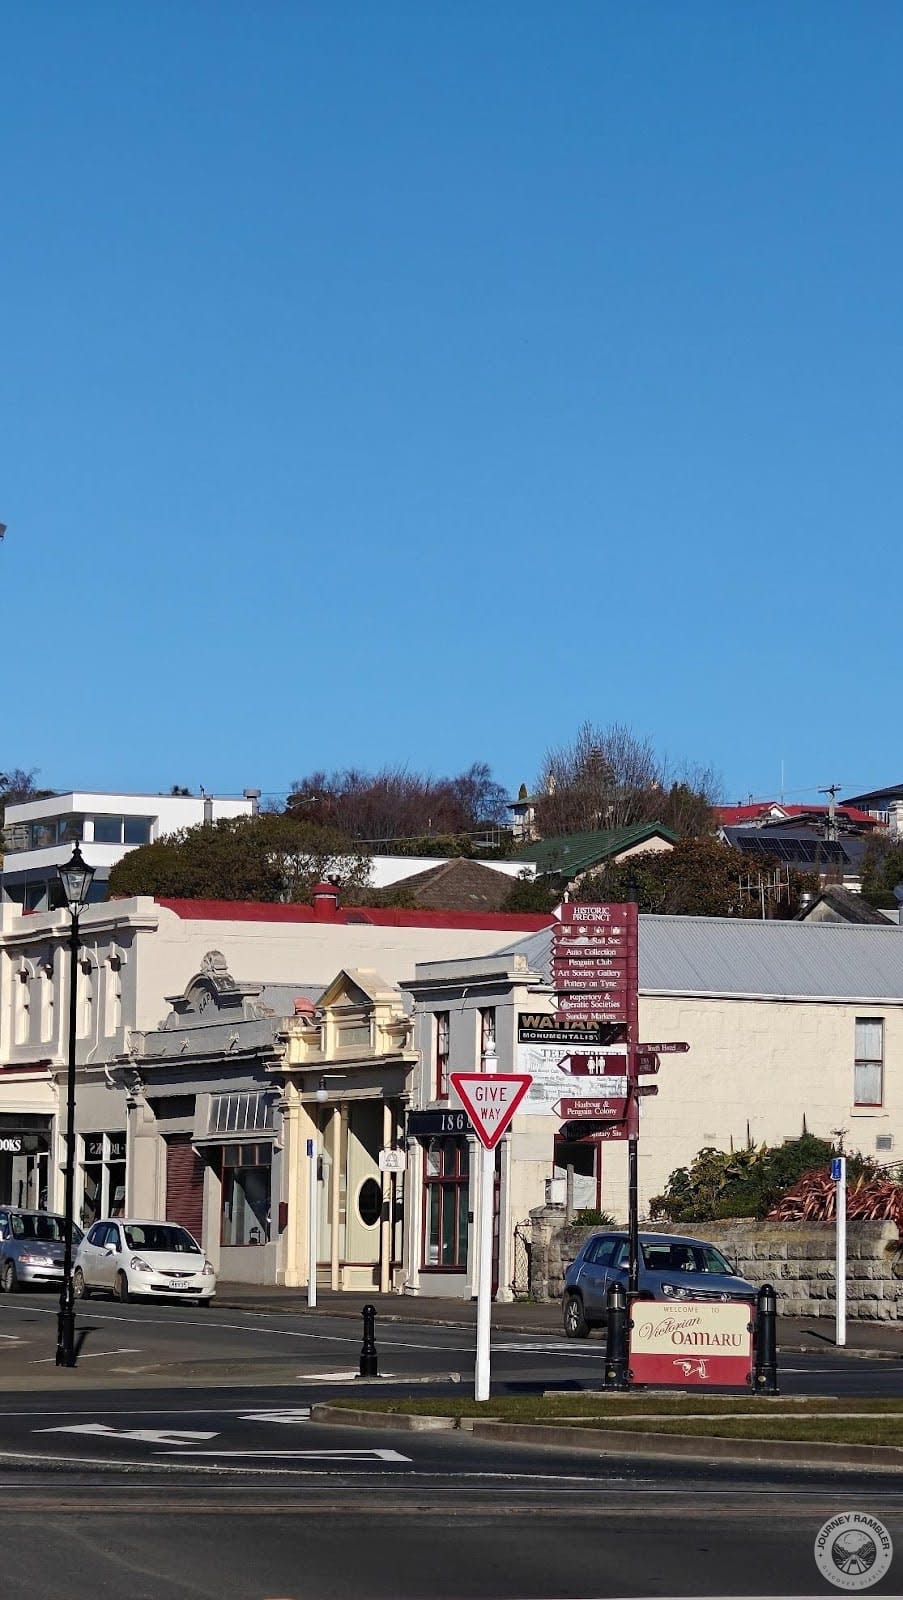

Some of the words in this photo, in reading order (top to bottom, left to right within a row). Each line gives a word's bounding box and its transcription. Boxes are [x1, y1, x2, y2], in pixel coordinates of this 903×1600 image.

[584, 948, 617, 956] Collection
[568, 959, 594, 967] Penguin
[572, 970, 595, 978] Society
[597, 969, 621, 978] Gallery
[563, 980, 587, 988] Pottery
[600, 980, 617, 989] Tyne
[569, 994, 602, 1002] Repertory
[566, 1013, 588, 1021] Sunday
[590, 1012, 616, 1020] Markets
[475, 1086, 508, 1102] GIVE
[574, 1100, 601, 1108] Harbour
[602, 1100, 610, 1108] &
[480, 1107, 501, 1120] WAY
[567, 1108, 592, 1117] Penguin
[594, 1107, 617, 1116] Colony
[638, 1316, 704, 1340] Victorian
